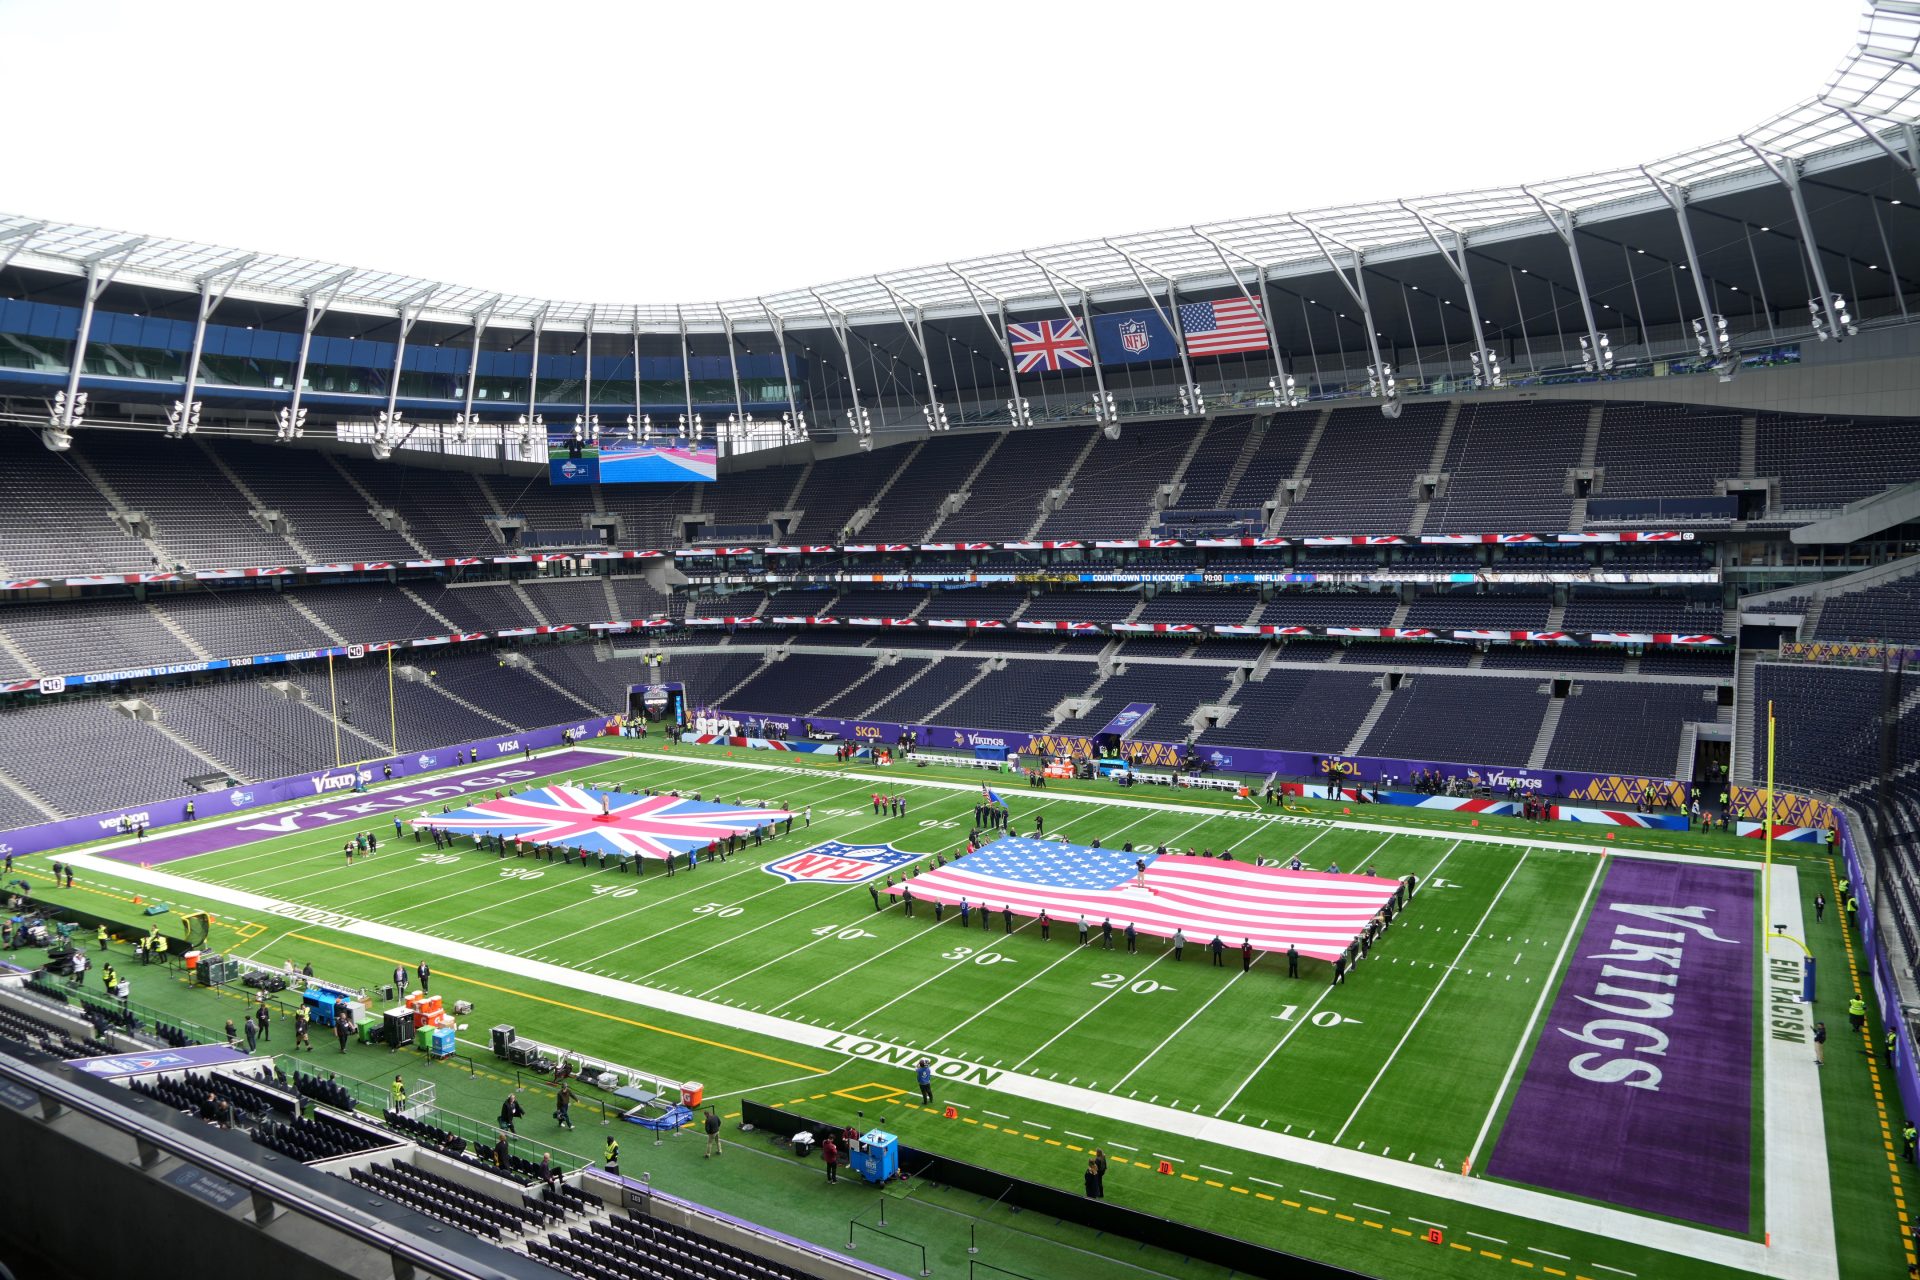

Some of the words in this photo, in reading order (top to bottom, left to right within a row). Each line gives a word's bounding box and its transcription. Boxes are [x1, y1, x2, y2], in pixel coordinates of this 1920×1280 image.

[1125, 334, 1146, 349] NFL
[1093, 574, 1140, 582] COUNTDOWN
[1141, 574, 1151, 582] TO
[1152, 574, 1185, 582] KICKOFF
[1204, 574, 1222, 582] 90:00
[1254, 574, 1286, 582] #NFLUK
[350, 647, 362, 656] 40
[231, 657, 252, 667] 90:00
[84, 669, 151, 684] COUNTDOWN
[153, 667, 167, 676] TO
[168, 662, 209, 674] KICKOFF
[43, 679, 61, 692] 40
[497, 740, 519, 753] VISA
[777, 854, 876, 880] NFL
[263, 902, 361, 928] LONDON
[692, 902, 745, 918] 50
[811, 925, 865, 940] 40
[942, 946, 1002, 965] 30
[1770, 958, 1801, 984] END
[1091, 973, 1159, 994] 20
[1270, 1004, 1342, 1028] 10
[824, 1034, 1003, 1086] LONDON
[683, 1093, 691, 1102] G
[1161, 1162, 1169, 1173] 10
[1431, 1231, 1439, 1242] G
